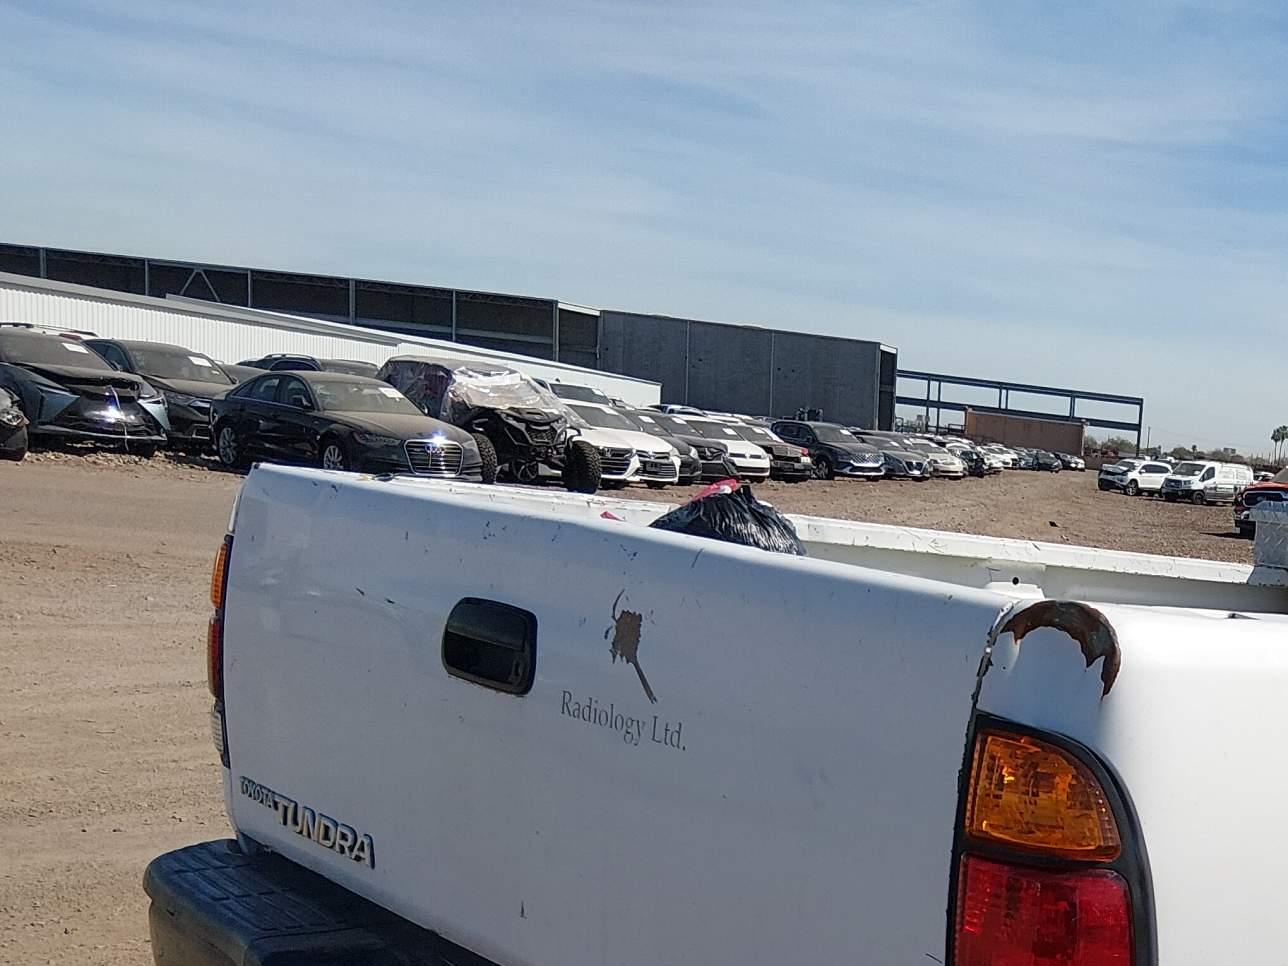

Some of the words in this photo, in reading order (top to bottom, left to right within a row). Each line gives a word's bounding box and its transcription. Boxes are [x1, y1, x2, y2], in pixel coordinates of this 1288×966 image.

[561, 690, 645, 746] Radiology
[652, 715, 686, 751] Ltd.
[240, 776, 275, 808] TOYOTA
[274, 794, 375, 869] TUNDRA
